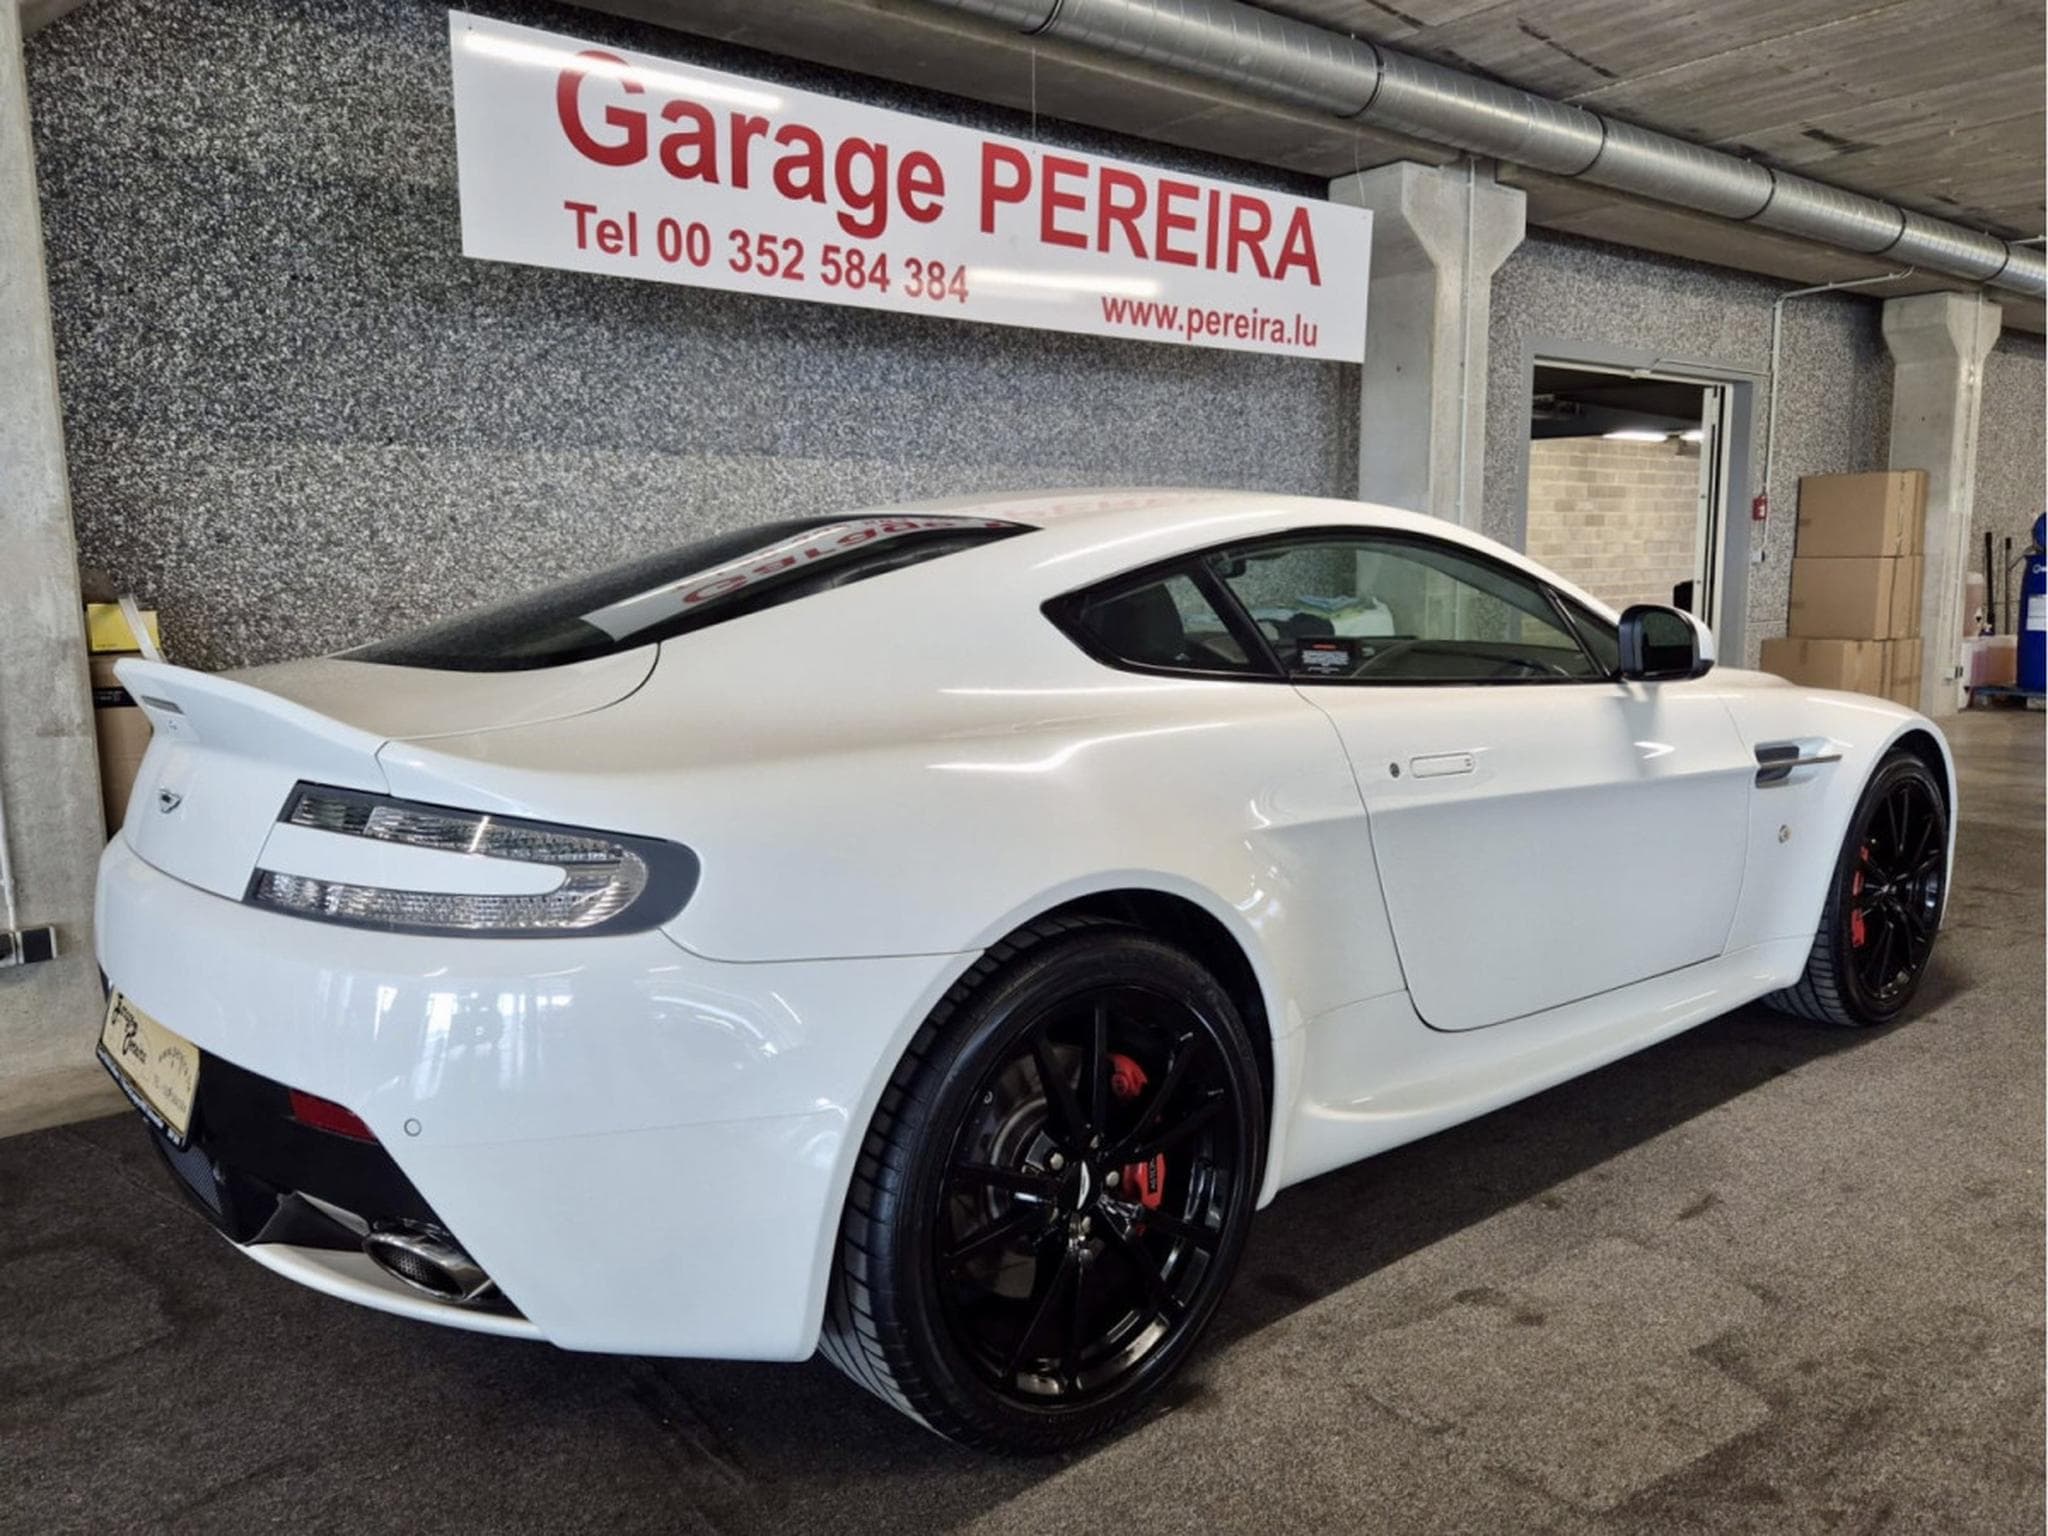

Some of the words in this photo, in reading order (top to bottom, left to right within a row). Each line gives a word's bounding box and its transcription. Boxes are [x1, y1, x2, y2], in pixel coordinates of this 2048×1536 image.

[555, 49, 947, 240] Garage
[979, 140, 1322, 287] PEREIRA
[563, 201, 639, 257] Tel
[656, 217, 713, 268] 00
[728, 228, 806, 283] 352
[820, 243, 891, 294] 584
[903, 256, 970, 304] 384
[1102, 296, 1319, 348] www.pereira.lu
